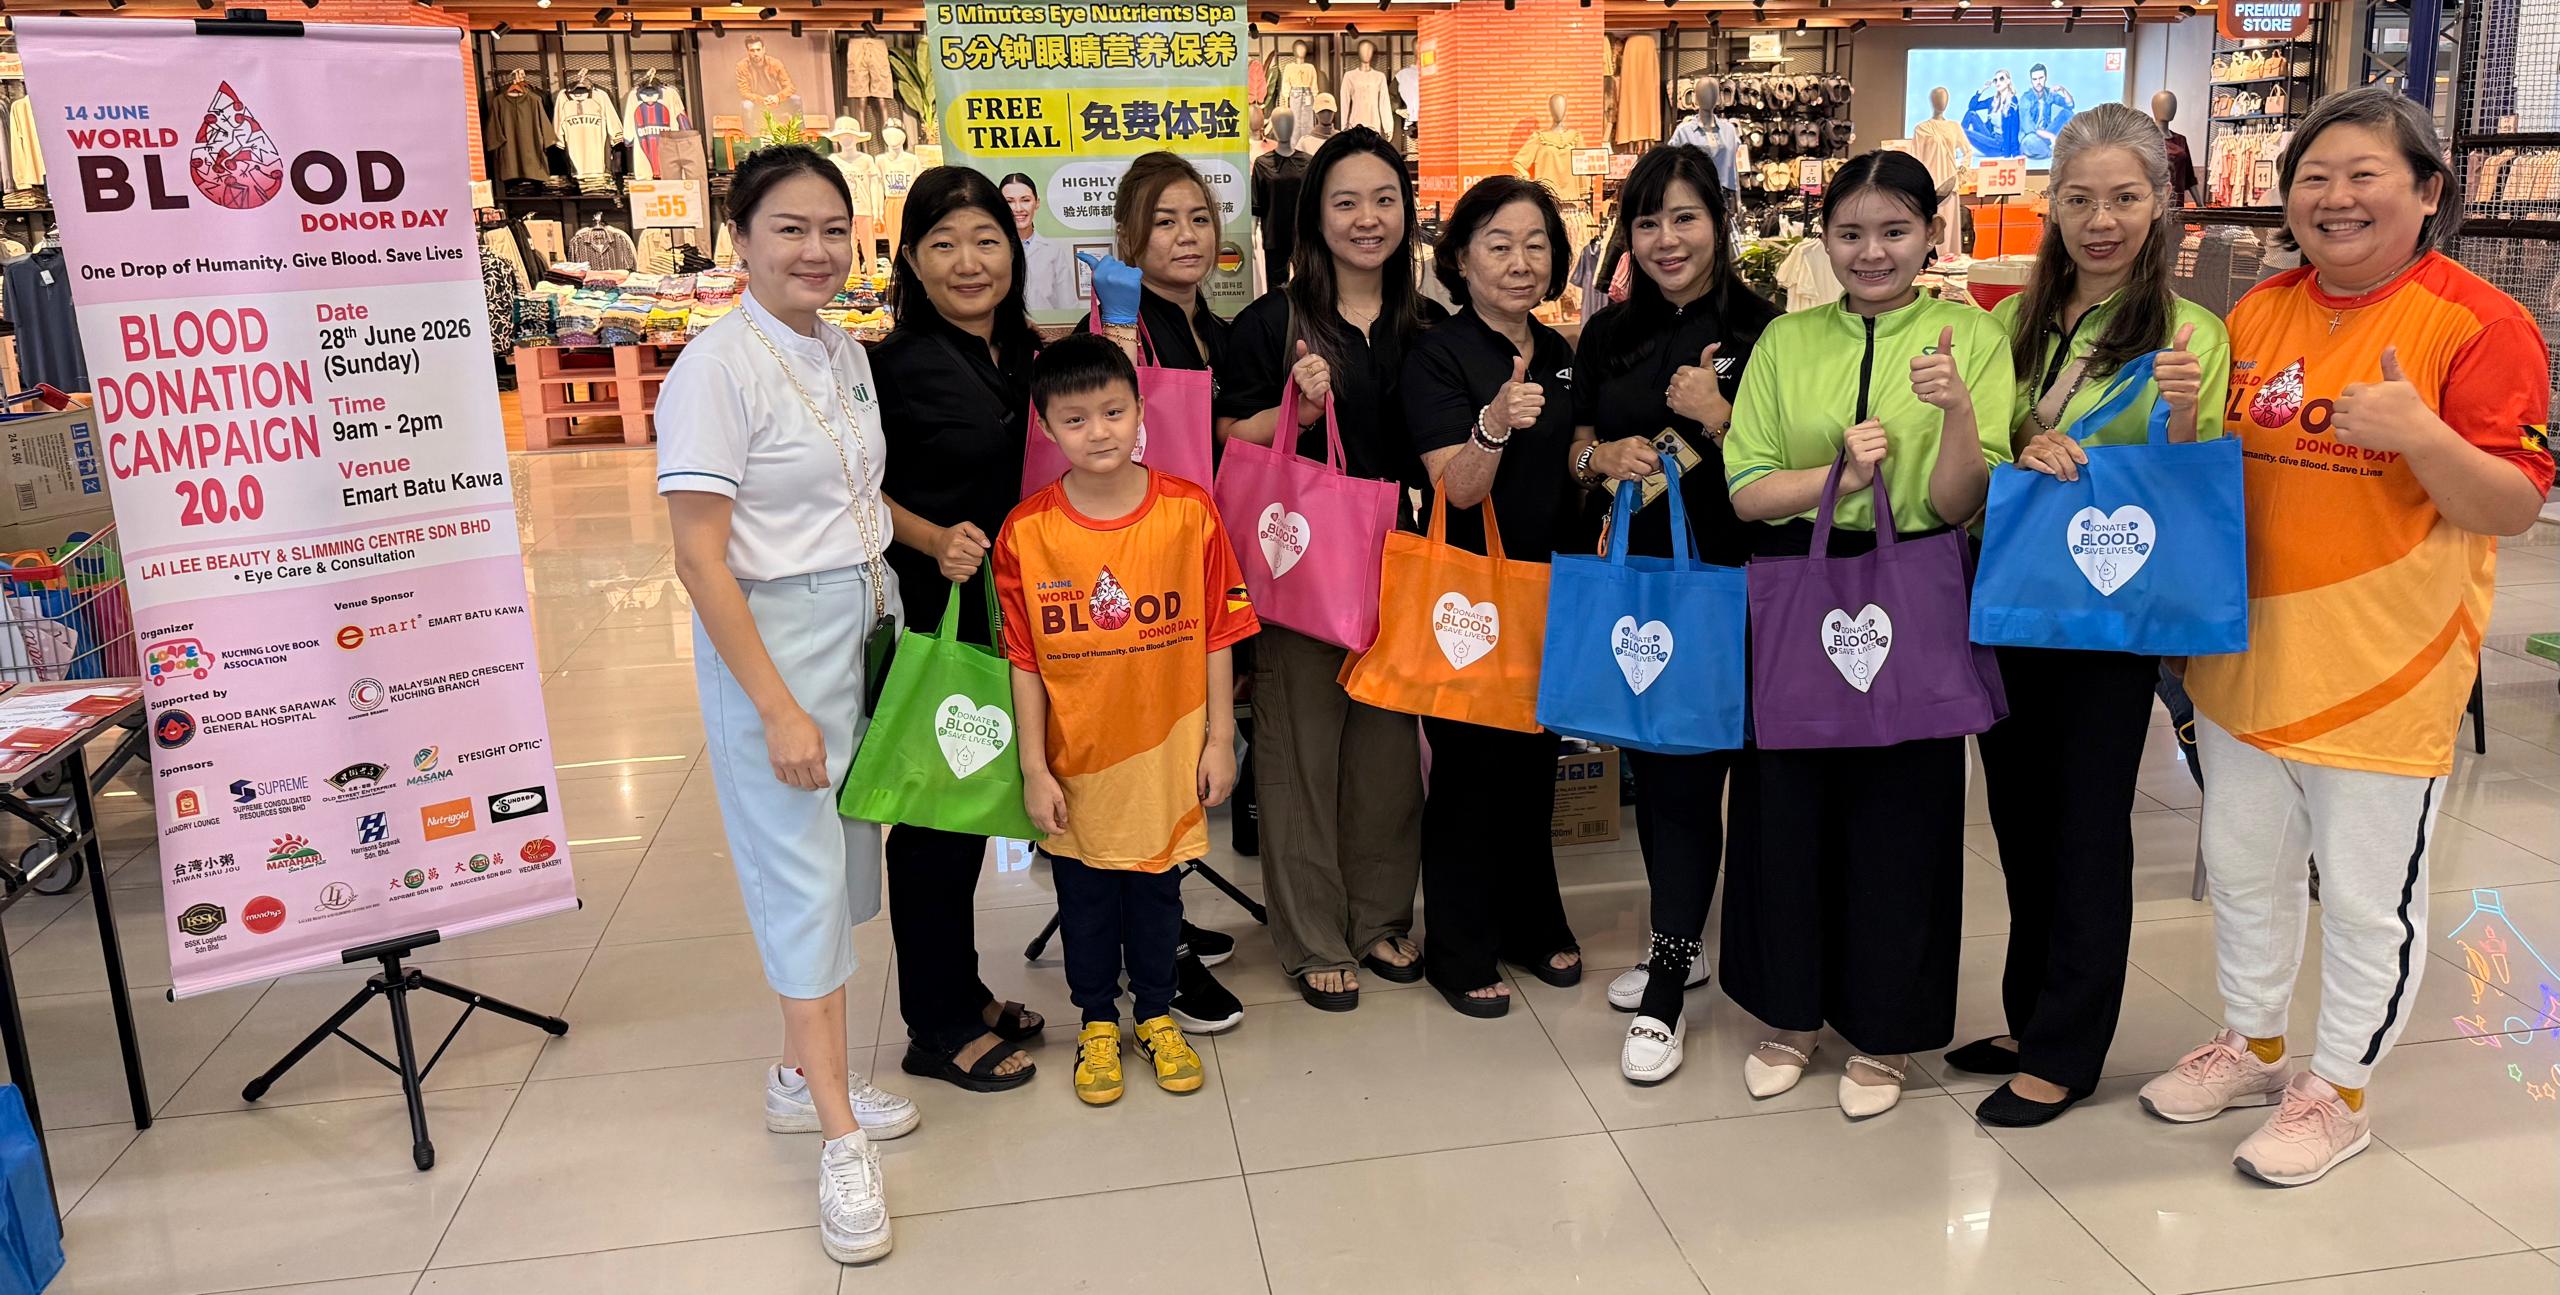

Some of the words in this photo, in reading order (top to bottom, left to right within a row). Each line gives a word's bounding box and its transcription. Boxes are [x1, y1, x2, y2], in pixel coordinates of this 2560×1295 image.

[939, 5, 951, 24] 5
[956, 4, 1045, 24] Minutes
[1049, 5, 1085, 28] Eye
[1091, 4, 1193, 23] Nutrients
[1197, 5, 1235, 27] Spa
[2235, 4, 2301, 17] PREMIUM
[2243, 18, 2292, 32] STORE
[941, 31, 1238, 70] 5分钟眼睛营养保养
[64, 105, 89, 121] 14
[93, 105, 150, 121] JUNE
[966, 98, 1043, 121] FREE
[1080, 99, 1240, 141] 免费体验
[67, 128, 179, 150] WORLD
[968, 126, 1061, 149] TRIAL
[1062, 176, 1116, 188] HIGHLY
[1999, 169, 2016, 186] 55
[657, 195, 687, 217] 55
[1084, 191, 1102, 201] BY
[301, 211, 396, 233] DONOR
[402, 209, 449, 230] DAY
[81, 264, 117, 281] One
[121, 261, 168, 281] Drop
[172, 259, 191, 275] of
[197, 255, 288, 274] Humanity.
[292, 252, 328, 268] Give
[331, 248, 383, 266] Blood.
[386, 246, 422, 263] Save
[425, 244, 464, 261] Lives
[316, 303, 369, 323] Date
[119, 307, 269, 362] BLOOD
[363, 324, 416, 348] June
[422, 318, 472, 342] 2026
[324, 348, 421, 382] (Sunday)
[97, 359, 314, 424] DONATION
[329, 395, 386, 417] Time
[332, 421, 378, 442] 9am
[397, 413, 443, 437] 2pm
[109, 414, 321, 480] CAMPAIGN
[2295, 437, 2358, 460] DONOR
[2363, 448, 2401, 464] DAY
[338, 457, 411, 480] Venue
[2242, 450, 2277, 463] umanity.
[2278, 455, 2299, 467] Give
[2300, 459, 2330, 471] Blood.
[2332, 463, 2358, 475] Save
[2360, 467, 2384, 477] Lives
[342, 483, 399, 507] Emart
[403, 477, 446, 499] Batu
[451, 469, 503, 492] Kawa
[176, 474, 264, 527] 20.0
[1267, 523, 1298, 545] BLOOD
[2081, 532, 2139, 546] BLOOD
[141, 564, 167, 581] LAI
[170, 558, 202, 576] LEE
[206, 551, 272, 571] BEAUTY
[277, 548, 288, 563] &
[291, 537, 365, 561] SLIMMING
[368, 528, 424, 550] CENTRE
[428, 523, 457, 541] SDN
[461, 519, 491, 536] BHD
[2106, 546, 2134, 554] LIVES
[244, 567, 273, 586] Eye
[277, 563, 313, 580] Care
[317, 560, 328, 574] &
[330, 546, 416, 571] Consultation
[1036, 582, 1047, 590] 14
[1049, 580, 1073, 589] JUNE
[334, 598, 368, 611] Venue
[370, 590, 415, 605] Sponsor
[1037, 590, 1085, 603] WORLD
[428, 613, 462, 627] EMART
[465, 609, 492, 621] BATU
[494, 605, 524, 616] KAWA
[1442, 613, 1491, 635] BLOOD
[1452, 608, 1484, 622] DONATE
[140, 623, 194, 641] Organizer
[1139, 624, 1177, 640] DONOR
[1178, 618, 1199, 631] DAY
[1443, 625, 1463, 636] SAVE
[1464, 631, 1486, 641] LIVES
[1834, 629, 1878, 647] BLOOD
[1841, 623, 1869, 634] DONATE
[221, 646, 264, 659] KUCHING
[265, 643, 291, 654] LOVE
[292, 639, 320, 650] BOOK
[1062, 652, 1080, 661] Drop
[1091, 648, 1128, 657] Humanity.
[1128, 645, 1145, 653] Give
[1146, 642, 1166, 652] Blood.
[1166, 639, 1178, 647] Save
[1178, 635, 1194, 643] Lives
[1621, 638, 1660, 655] BLOOD
[1858, 642, 1877, 655] LIVES
[223, 655, 287, 670] ASSOCIATION
[1636, 655, 1657, 663] LIVES
[389, 675, 447, 694] MALAYSIAN
[449, 671, 470, 682] RED
[471, 662, 525, 678] CRESCENT
[150, 690, 209, 710] Supported
[212, 689, 228, 699] by
[390, 687, 436, 703] KUCHING
[438, 679, 480, 693] BRANCH
[201, 711, 242, 725] BLOOD
[245, 706, 277, 718] BANK
[279, 697, 337, 713] SARAWAK
[957, 712, 992, 726] DONATE
[203, 720, 258, 735] GENERAL
[260, 712, 316, 728] HOSPITAL
[946, 717, 998, 739] BLOOD
[947, 730, 967, 741] SAVE
[969, 735, 992, 746] LIVES
[458, 745, 506, 764] EYESIGHT
[159, 760, 214, 778] Sponsors
[406, 769, 454, 786] MASANA
[257, 776, 309, 796] SUPREME
[232, 802, 263, 814] SUPREME
[264, 795, 312, 811] CONSOLIDATED
[239, 808, 277, 821] RESOURCES
[279, 806, 292, 815] SDN
[293, 804, 306, 813] BHD
[165, 822, 192, 836] LAUNDRY
[193, 817, 220, 828] LOUNGE
[427, 810, 470, 828] Nutrigold
[351, 844, 378, 855] Harrisons
[378, 838, 401, 849] Sarawak
[266, 853, 323, 870] MATAHARI
[519, 864, 541, 874] WECARE
[541, 859, 562, 869] BAKERY
[172, 872, 202, 886] TAIWAN
[205, 869, 223, 878] SIAU
[225, 865, 241, 875] JOU
[186, 913, 219, 928] BSSK
[184, 939, 201, 949] BSSK
[202, 934, 228, 946] Logistics
[195, 945, 206, 954] Sdn
[207, 943, 219, 951] Bhd
